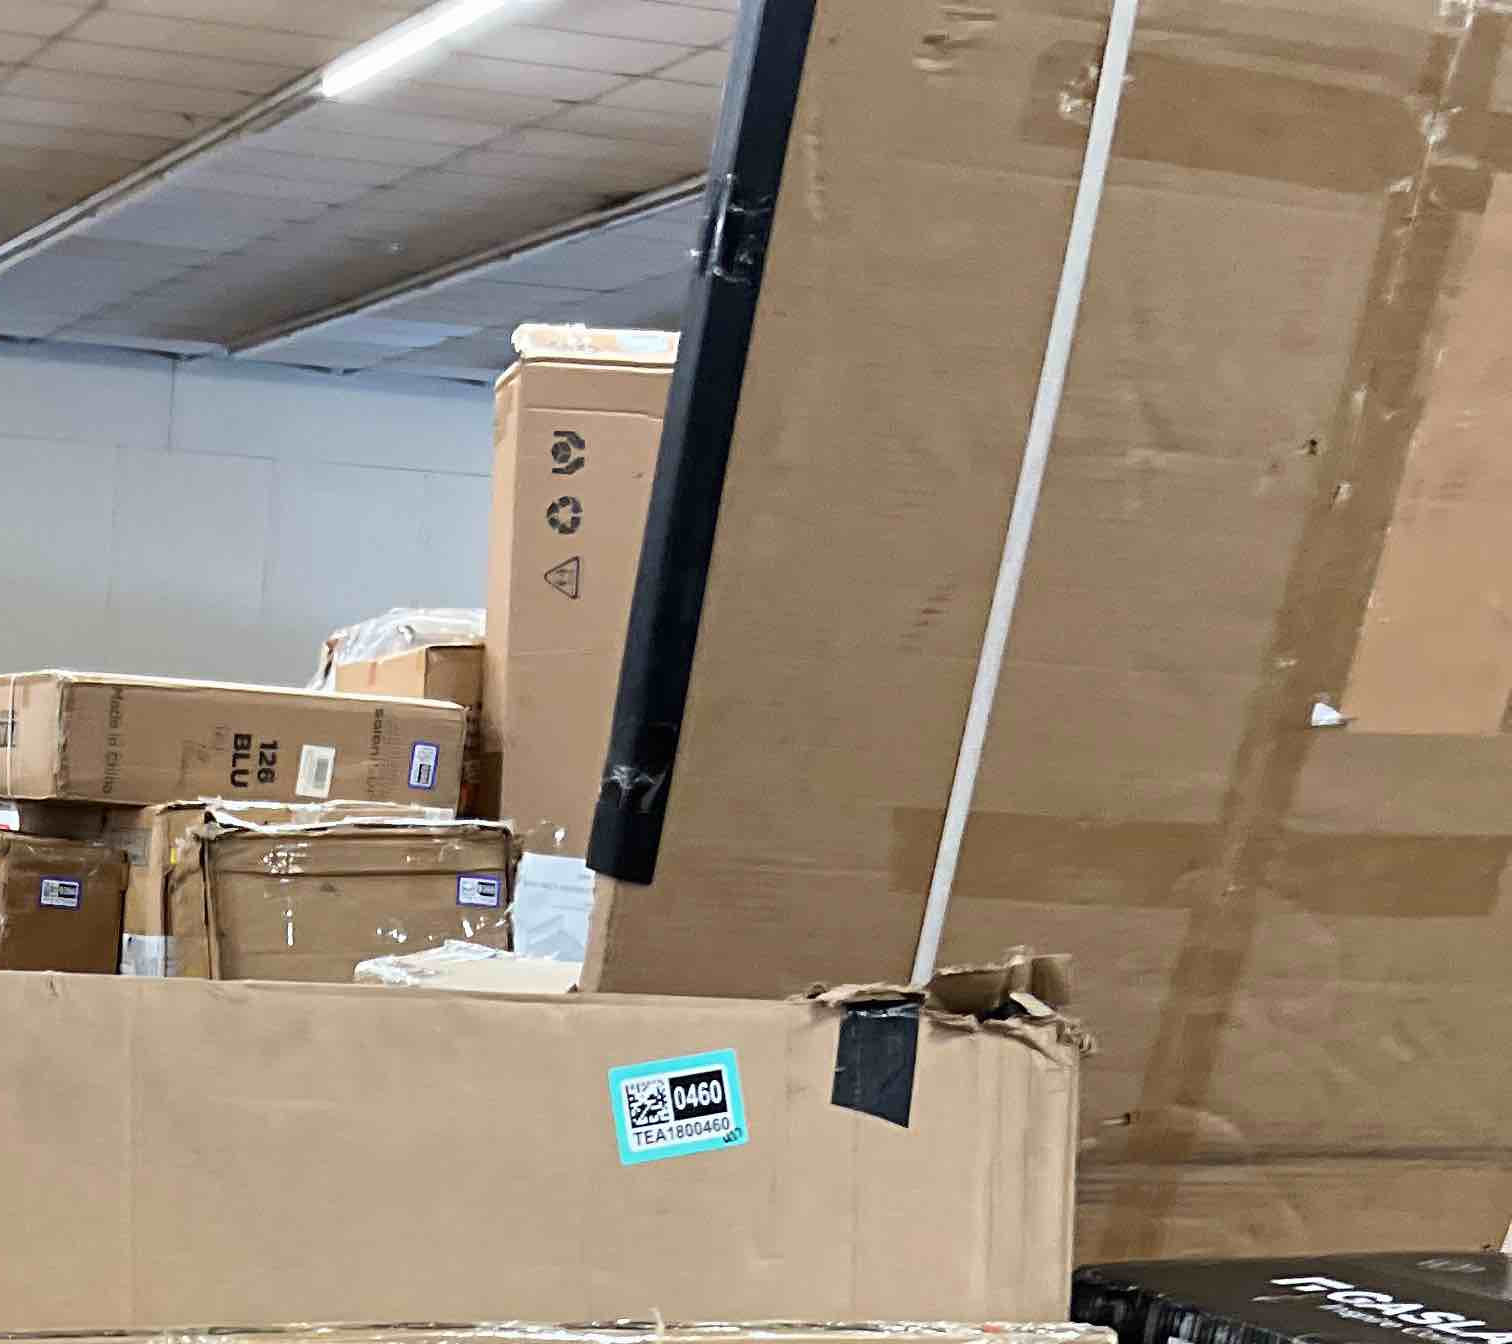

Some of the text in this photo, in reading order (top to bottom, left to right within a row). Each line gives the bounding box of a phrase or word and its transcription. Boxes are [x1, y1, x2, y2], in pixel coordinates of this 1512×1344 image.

[229, 733, 253, 789] BLU
[257, 740, 278, 784] 126
[673, 1079, 723, 1111] 0460
[632, 1116, 730, 1146] TEA1800460
